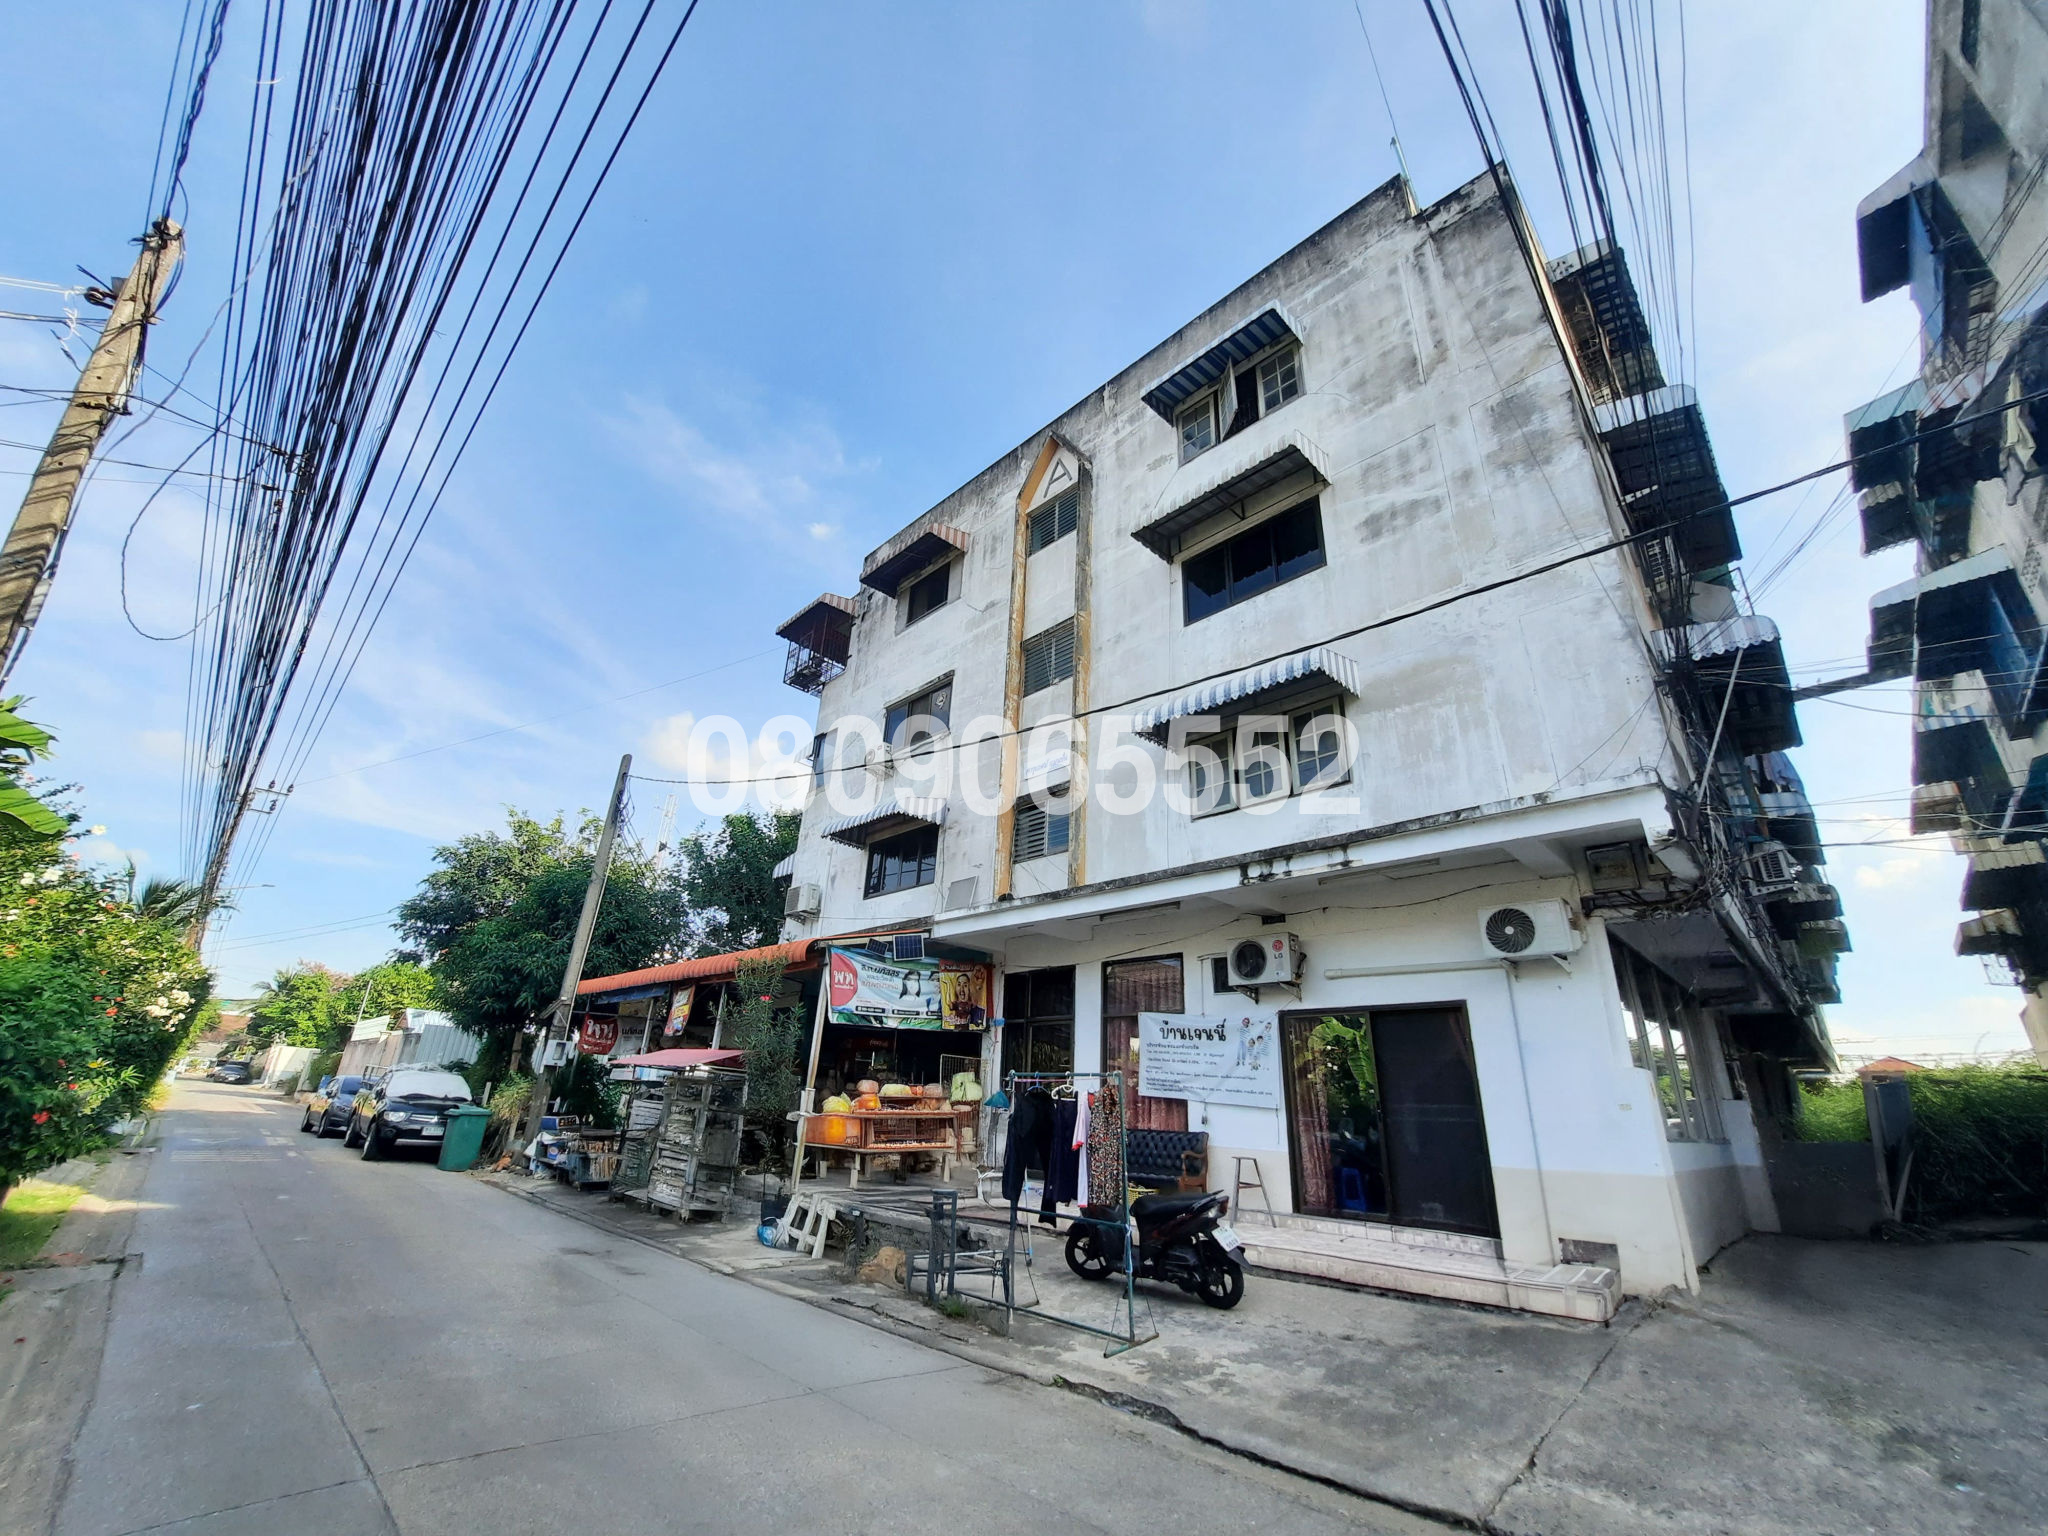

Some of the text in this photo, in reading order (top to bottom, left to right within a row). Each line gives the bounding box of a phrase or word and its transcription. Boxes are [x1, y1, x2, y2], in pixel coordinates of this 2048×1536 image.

[1043, 457, 1073, 499] A
[1273, 952, 1284, 960] LG
[1159, 1018, 1227, 1041] บ้านเจนนี่
